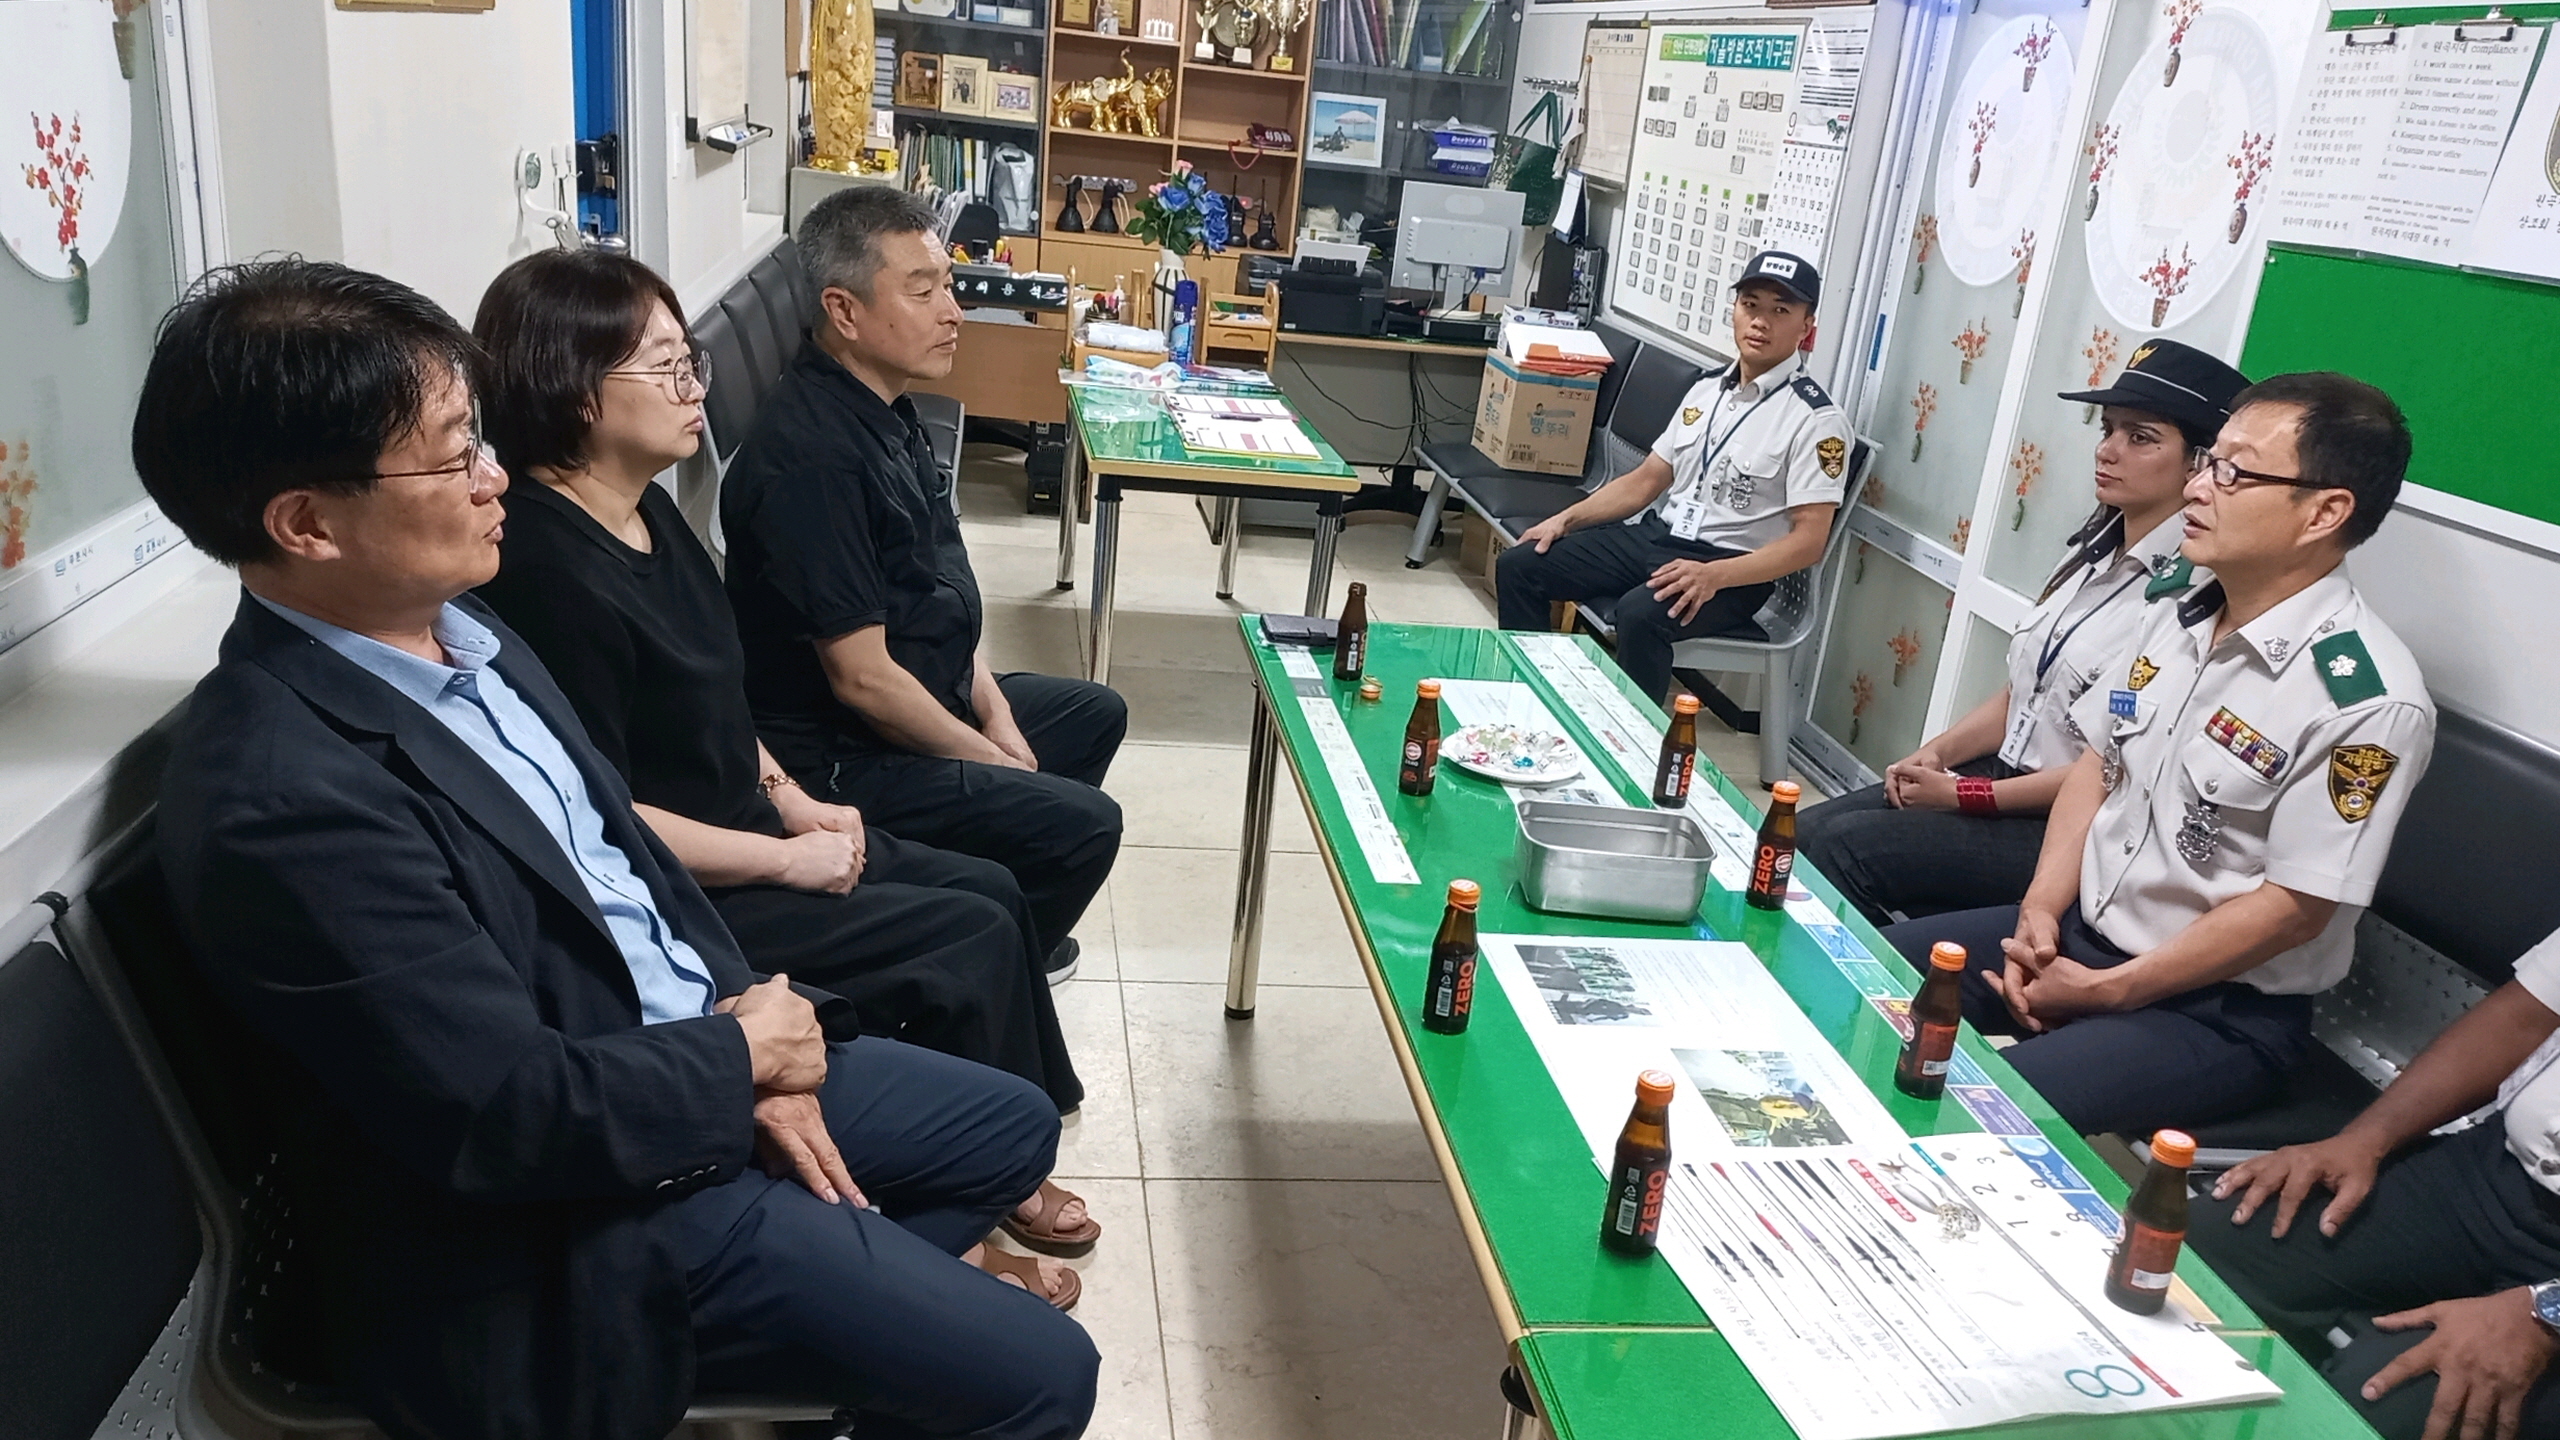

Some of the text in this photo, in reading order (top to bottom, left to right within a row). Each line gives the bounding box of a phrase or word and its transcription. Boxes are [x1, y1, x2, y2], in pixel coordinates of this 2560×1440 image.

[1709, 37, 1794, 67] 자율방범조직기구표
[2433, 41, 2519, 55] 원곡지대 compliance
[2429, 60, 2447, 69] work
[2449, 62, 2466, 70] once
[2414, 74, 2442, 82] Remove
[2444, 76, 2462, 84] name
[2472, 77, 2494, 86] absent
[2495, 78, 2520, 87] without
[2404, 87, 2423, 96] leave
[2432, 89, 2450, 98] times
[2452, 91, 2476, 100] without
[2409, 102, 2430, 111] Dress
[2431, 104, 2460, 115] correctly
[2462, 106, 2475, 115] and
[2477, 107, 2499, 118] neatly
[1786, 111, 1798, 137] 9
[2438, 119, 2458, 129] Korean
[2467, 122, 2478, 131] the
[1451, 135, 1476, 144] Double
[2400, 131, 2426, 142] Keeping
[2440, 135, 2472, 146] Hierarchy
[2473, 137, 2500, 147] Process
[1792, 148, 1798, 158] 2
[1801, 149, 1807, 160] 3
[1811, 150, 1817, 160] 4
[1820, 151, 1826, 162] 5
[2396, 144, 2425, 155] Organize
[2427, 149, 2442, 157] your
[2443, 150, 2462, 159] office
[1451, 162, 1476, 172] Double
[2459, 167, 2488, 178] members
[1814, 175, 1821, 187] 12
[1791, 196, 1798, 206] 17
[1816, 201, 1824, 212] 20
[1776, 217, 1819, 236] 23 24 25 26 27
[2519, 215, 2551, 230] 상조회
[2371, 226, 2400, 239] 원곡지대
[1771, 240, 1779, 250] 30
[1766, 262, 1793, 273] 방범순찰
[1753, 845, 1775, 895] ZERO
[1453, 959, 1475, 1017] ZERO
[1977, 1155, 1996, 1166] 3
[1972, 1182, 2000, 1197] 2
[1638, 1168, 1667, 1237] ZERO
[2076, 1331, 2113, 1356] 2024
[2064, 1364, 2146, 1399] 8
